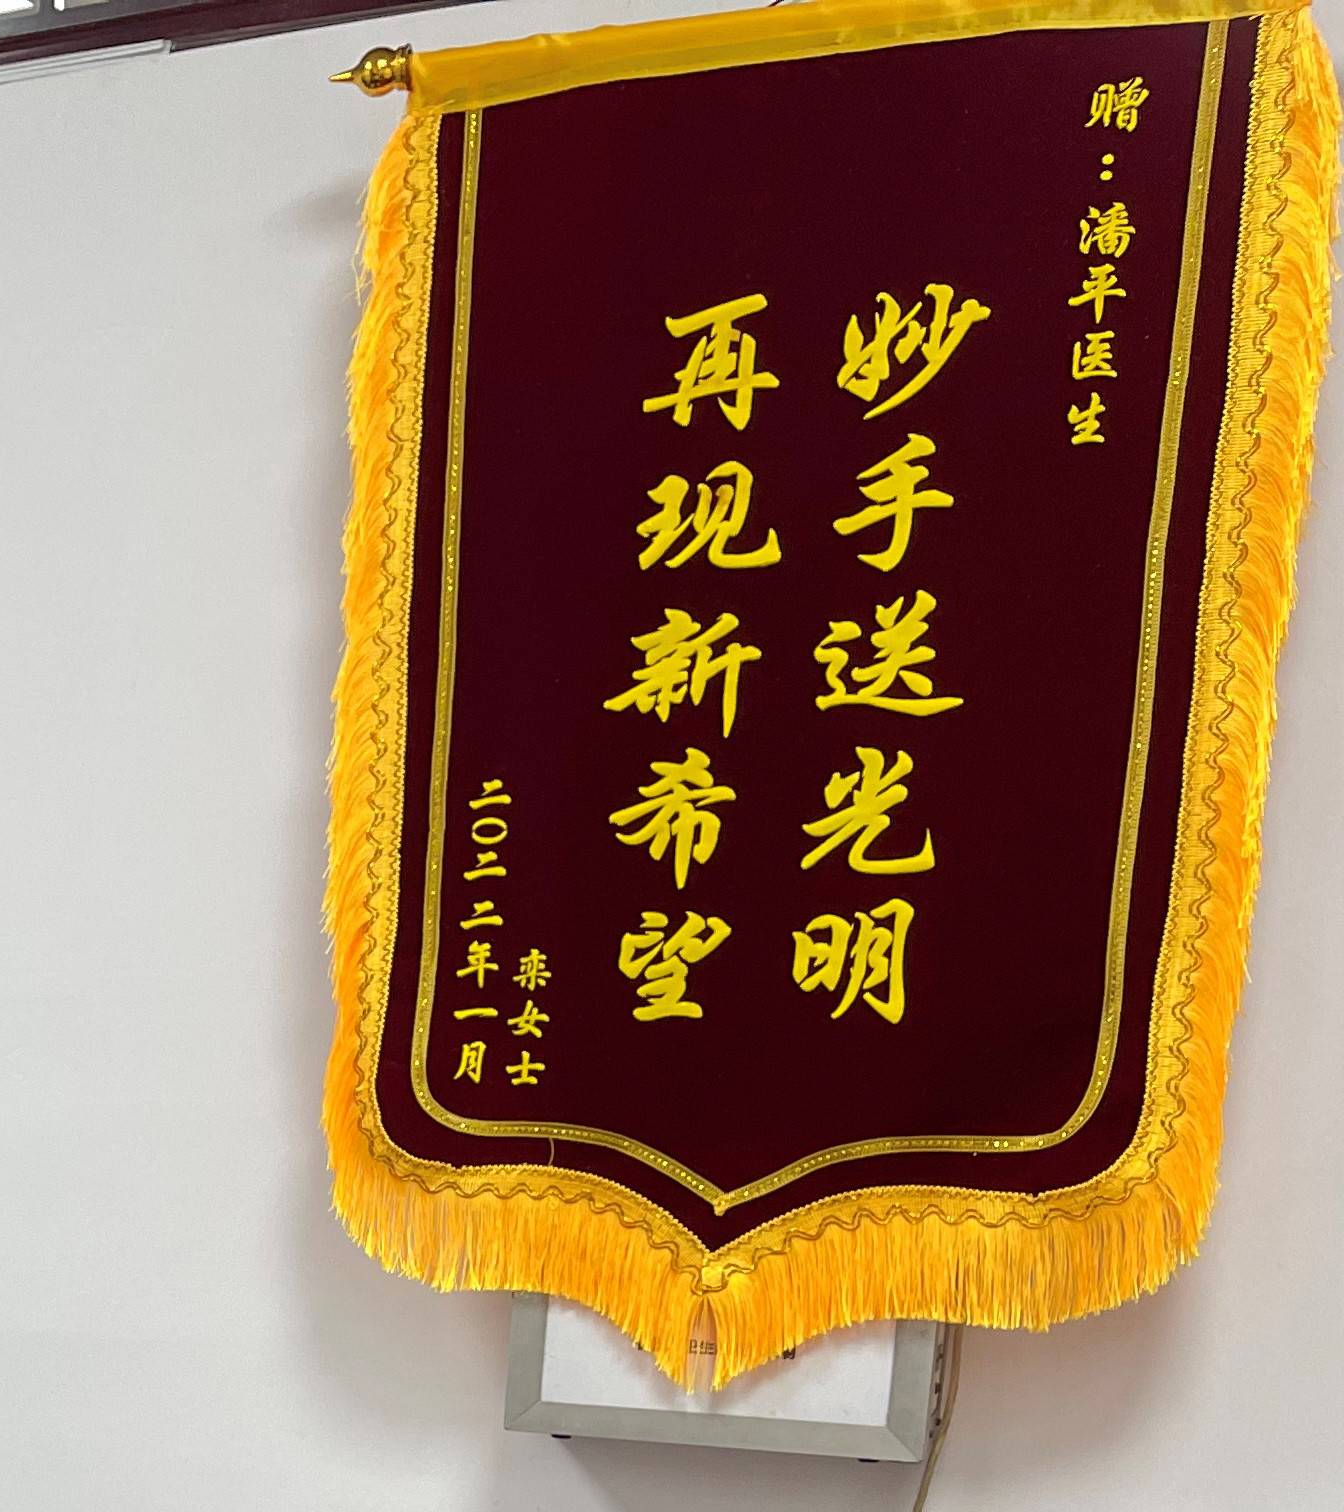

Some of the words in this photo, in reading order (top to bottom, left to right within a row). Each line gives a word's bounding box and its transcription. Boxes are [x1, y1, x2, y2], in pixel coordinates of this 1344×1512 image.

[602, 293, 782, 1022] 再现新希望
[791, 283, 991, 1025] 妙手送光明
